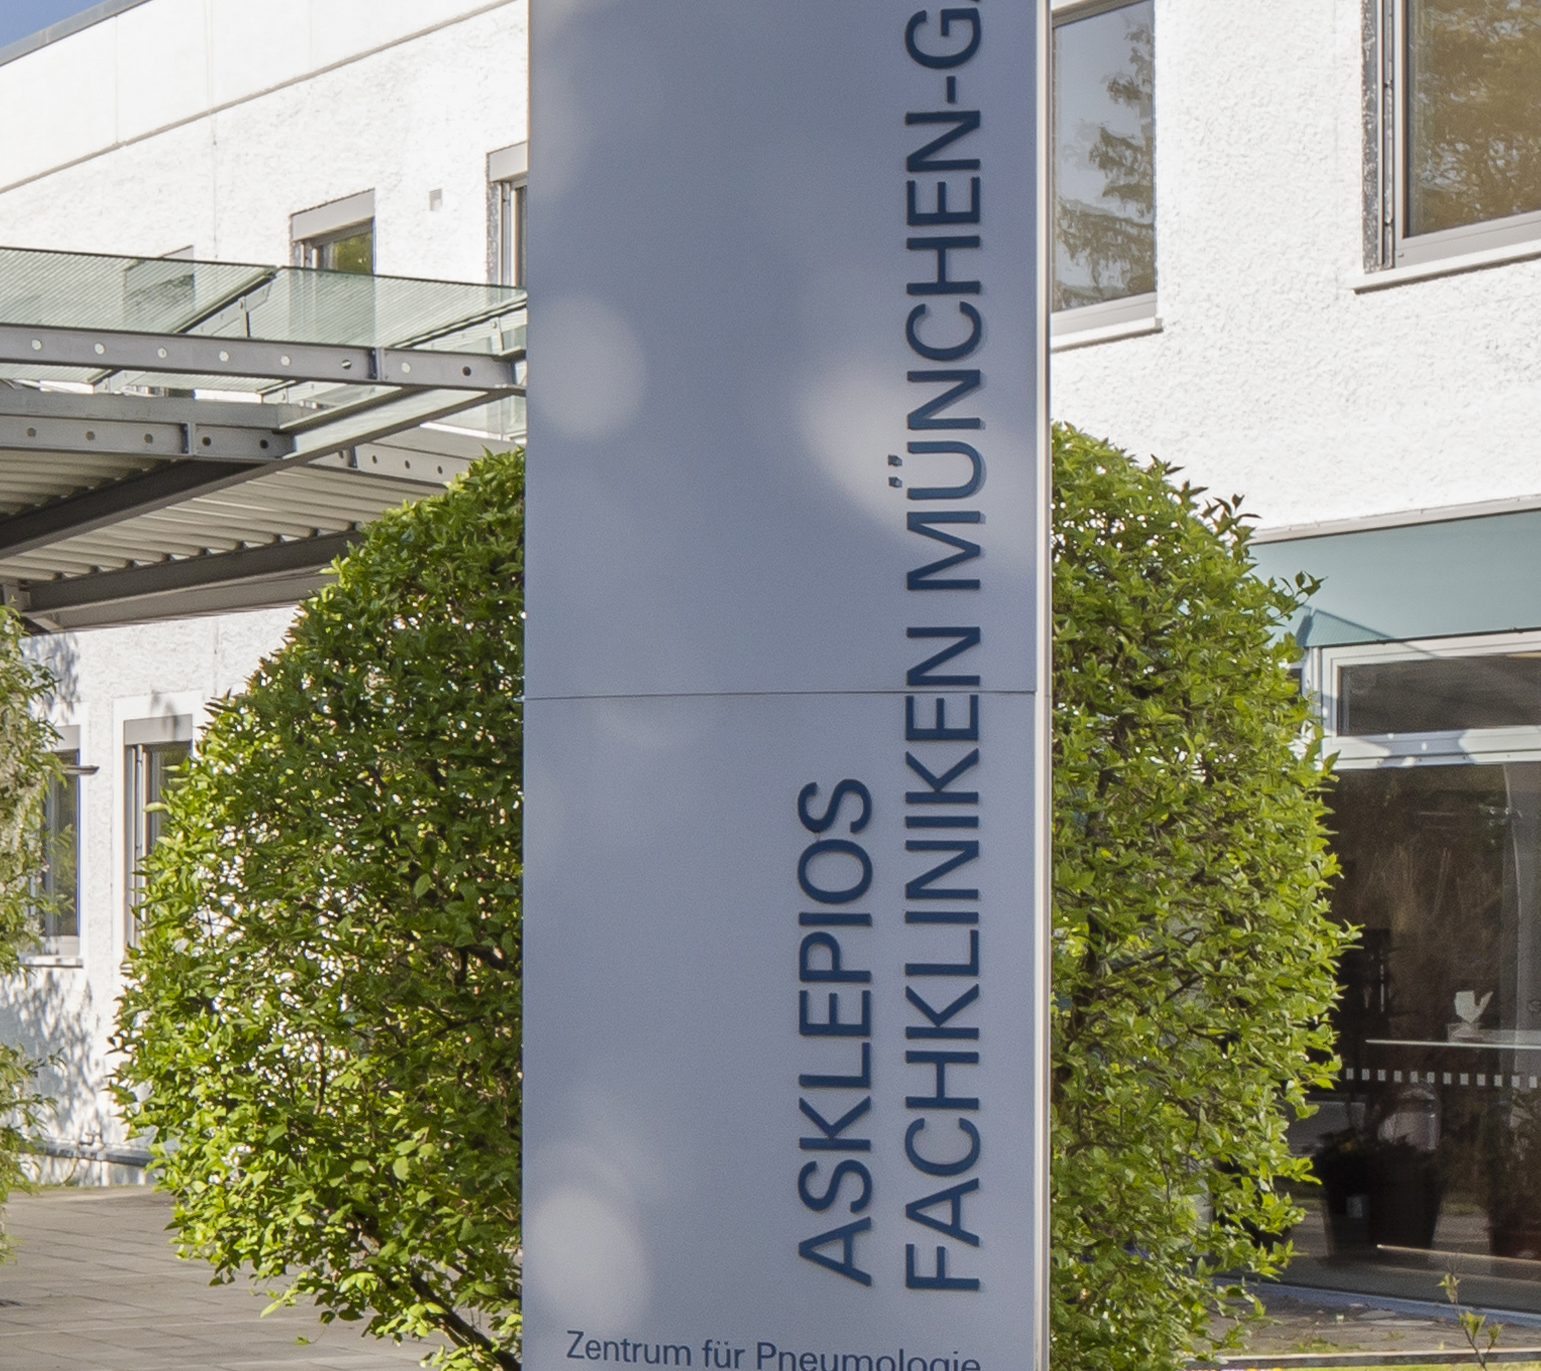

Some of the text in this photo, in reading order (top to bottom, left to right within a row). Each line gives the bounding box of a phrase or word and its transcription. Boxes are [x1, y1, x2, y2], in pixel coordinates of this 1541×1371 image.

[796, 778, 874, 1289] ASKLEPIOS
[904, 626, 982, 1293] FACHKLINIKEN
[566, 1329, 692, 1368] Zentrum
[701, 1338, 746, 1370] für
